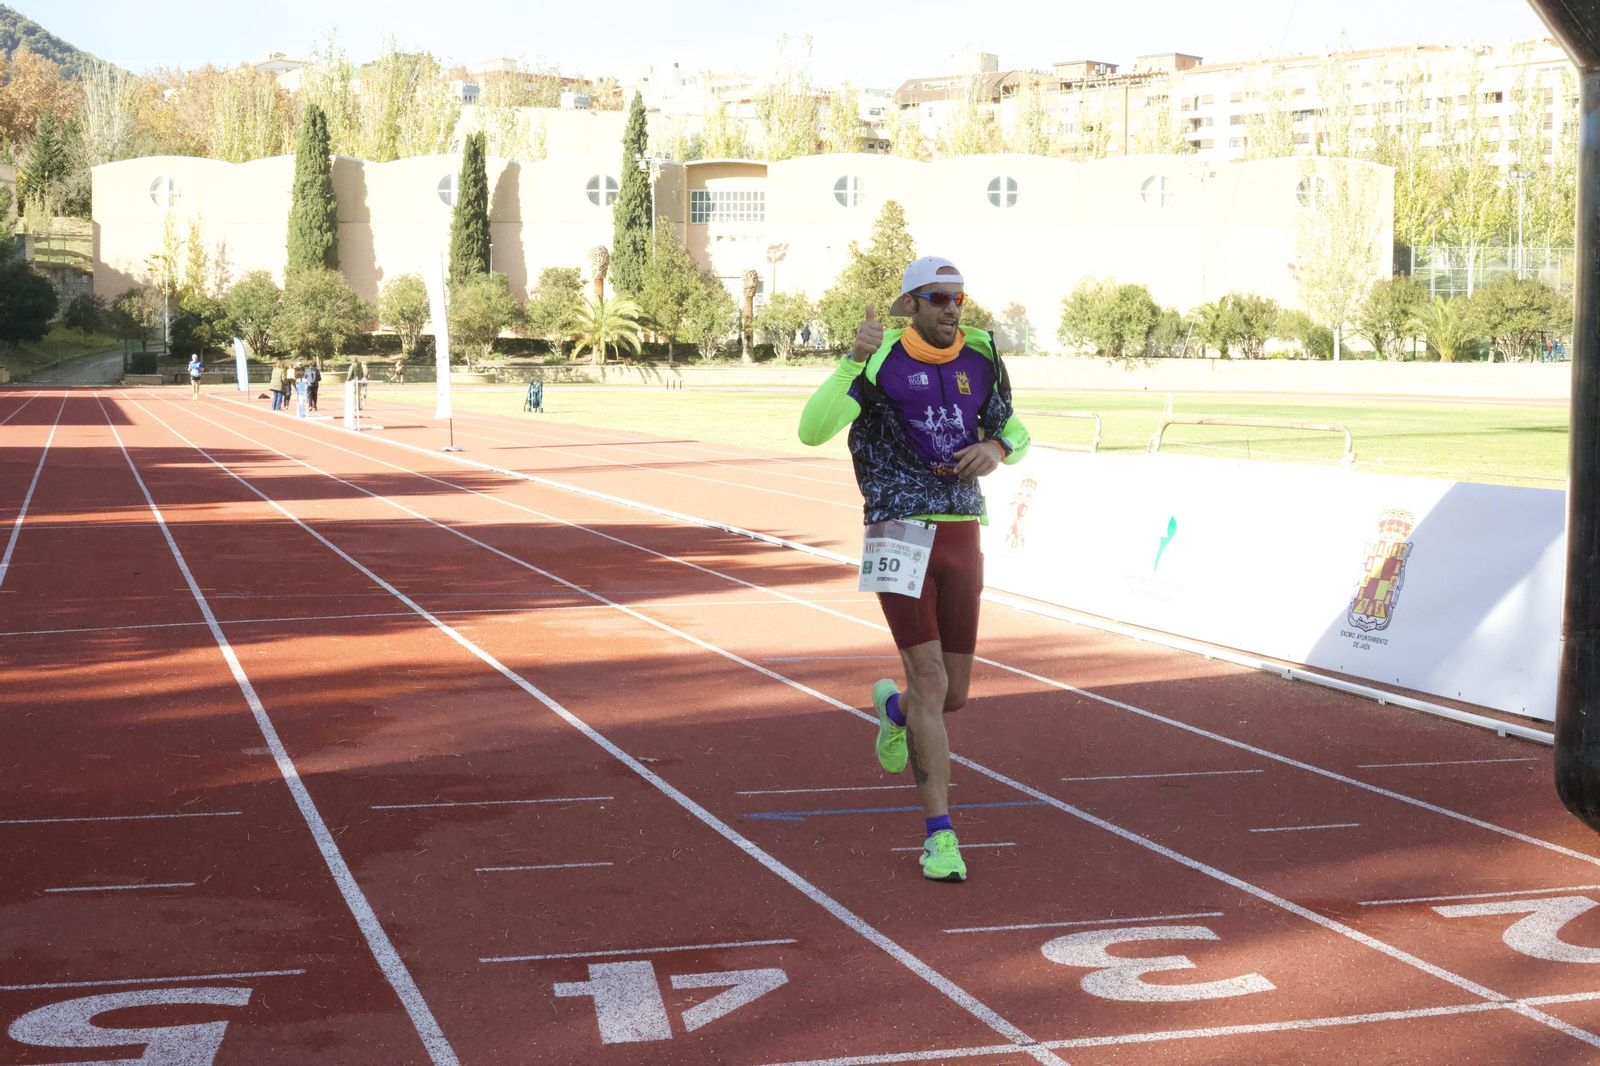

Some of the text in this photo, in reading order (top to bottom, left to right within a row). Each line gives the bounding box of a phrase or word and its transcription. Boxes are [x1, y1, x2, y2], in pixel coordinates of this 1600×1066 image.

[878, 557, 900, 572] 50
[1356, 633, 1389, 646] AYUNTAMIENTO
[1040, 926, 1277, 1002] 3
[1431, 895, 1600, 963] 2
[8, 987, 253, 1066] 5
[554, 960, 789, 1045] 4
